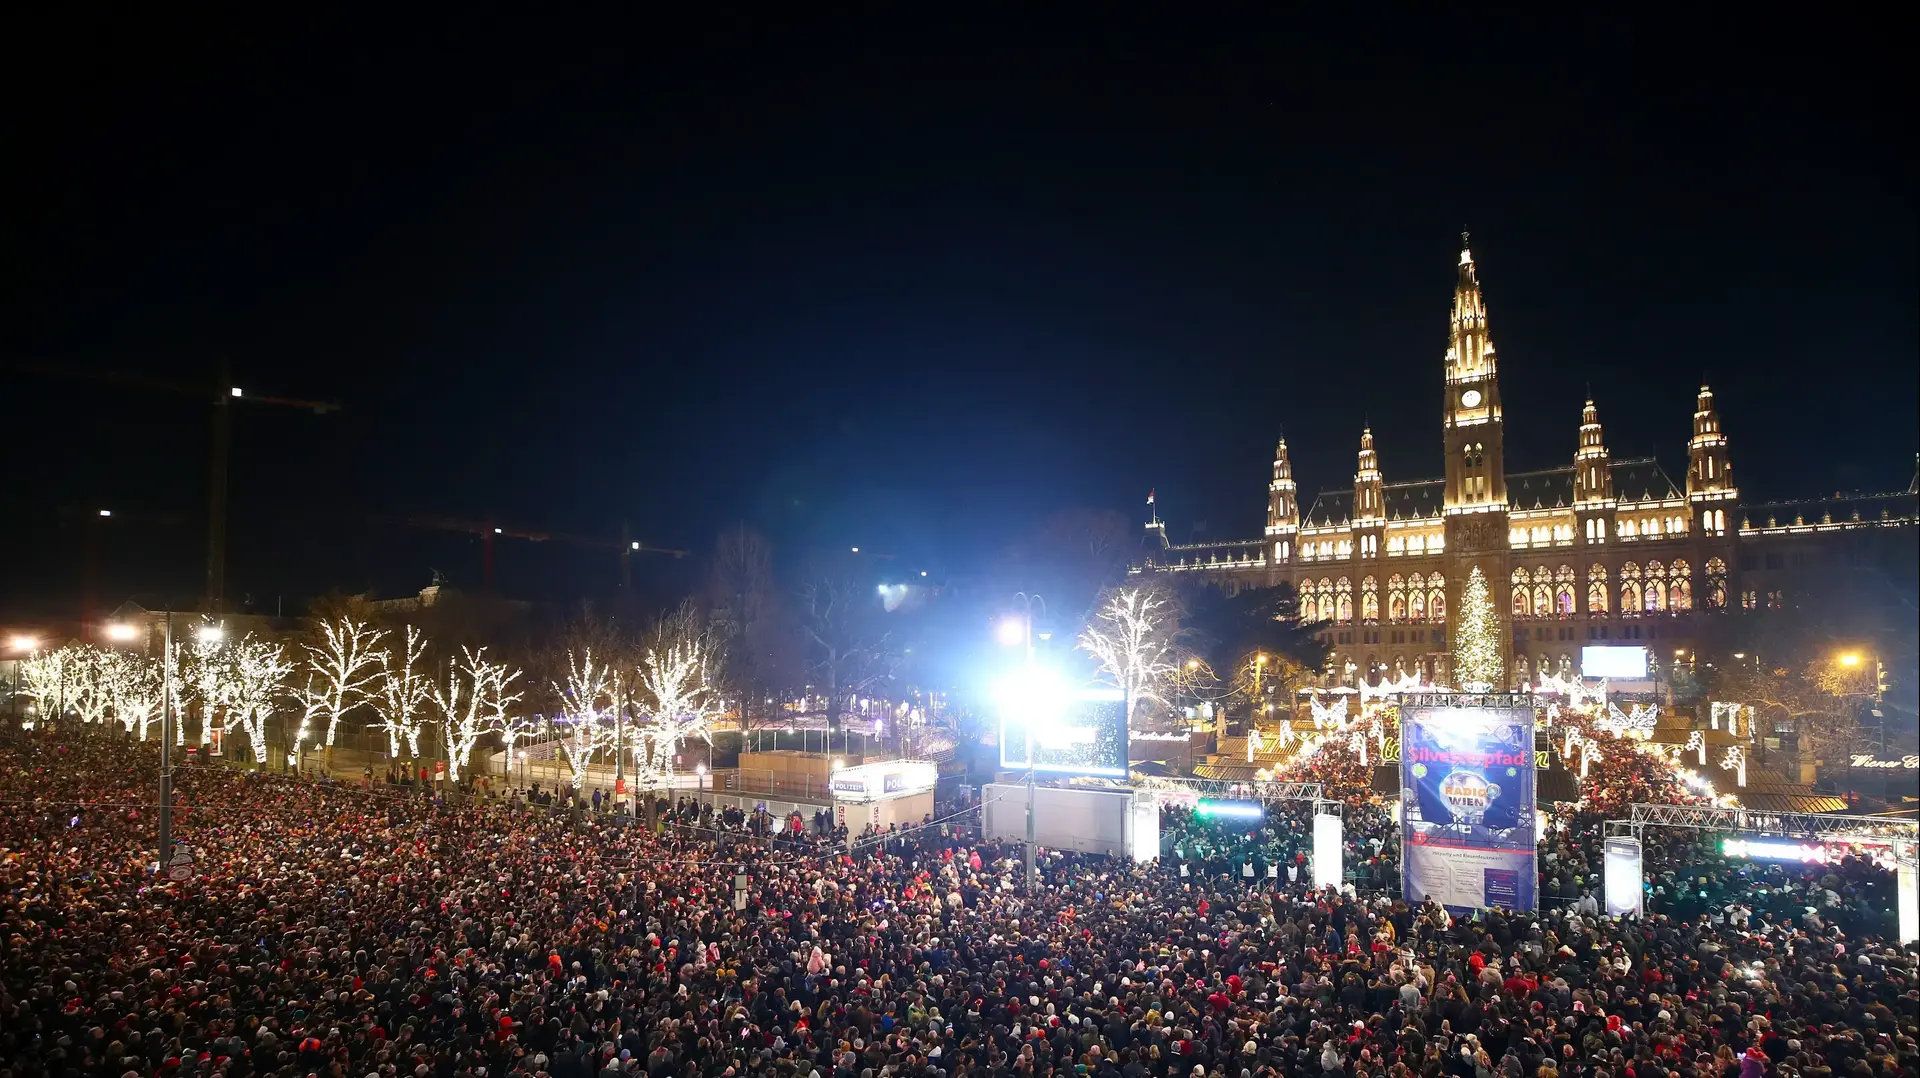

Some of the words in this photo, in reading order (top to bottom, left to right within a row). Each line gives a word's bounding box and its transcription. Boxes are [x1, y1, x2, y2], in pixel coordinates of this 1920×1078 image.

[1409, 747, 1525, 768] Silvesterpfad
[1850, 754, 1901, 767] Wiener
[1445, 786, 1487, 797] RADIO
[1448, 796, 1484, 807] WIEN
